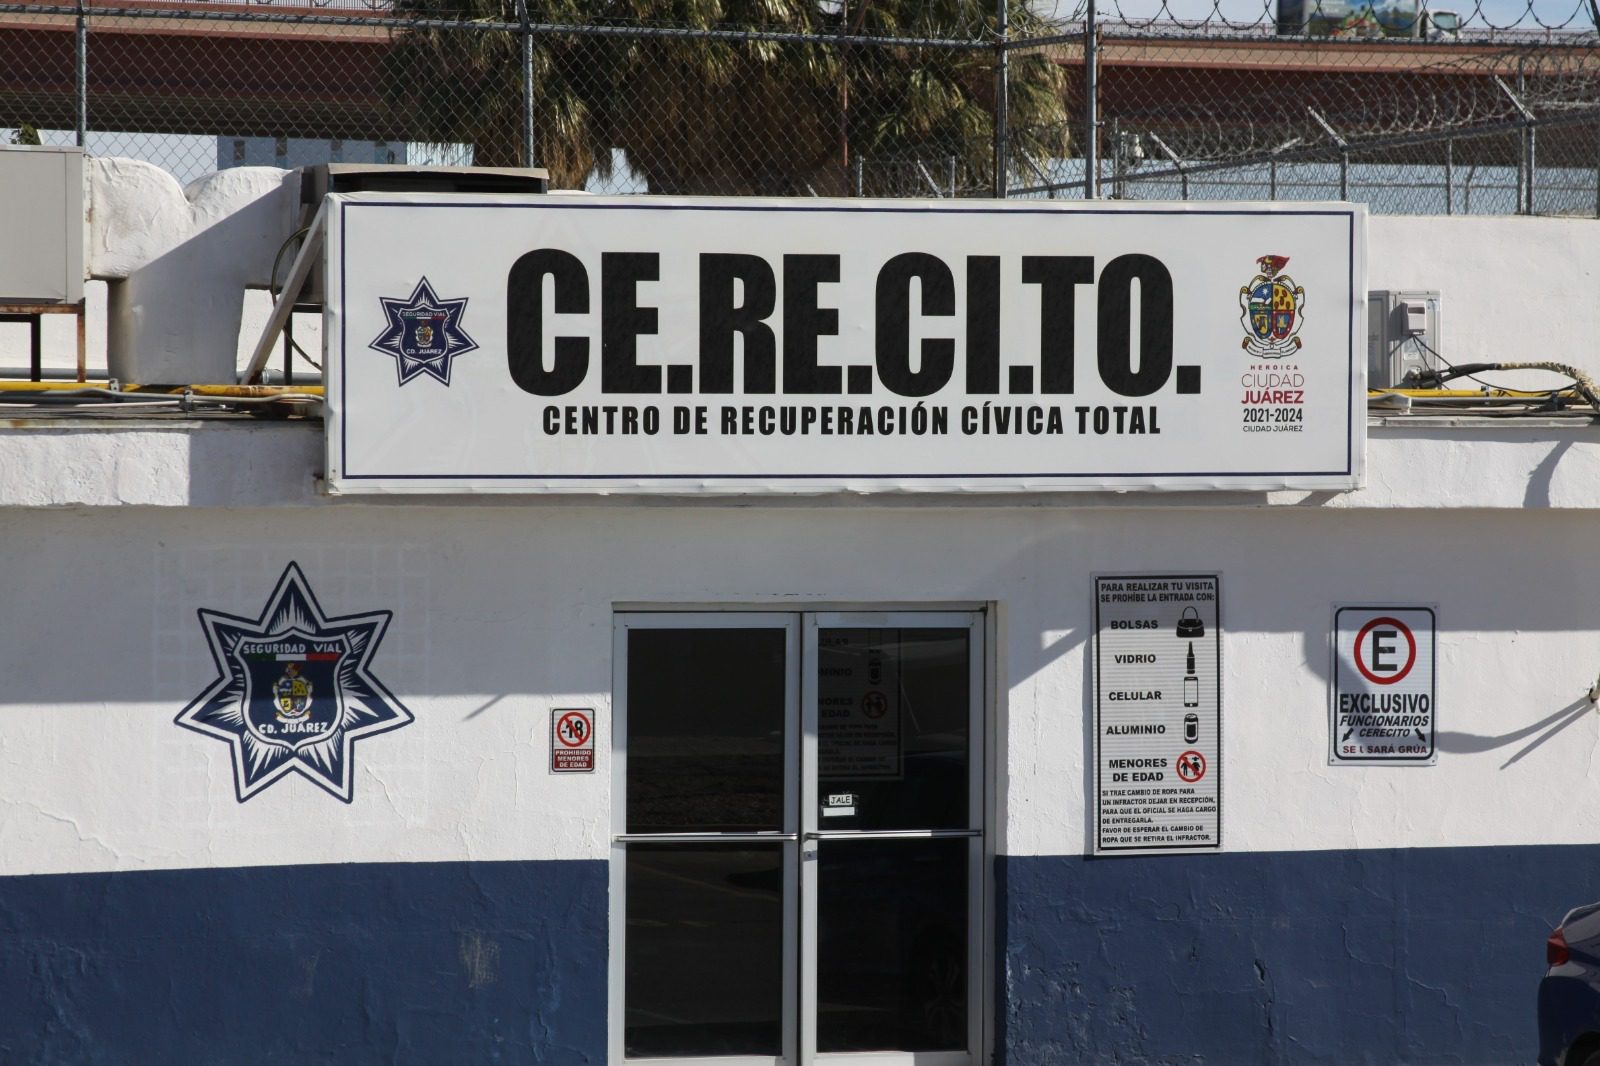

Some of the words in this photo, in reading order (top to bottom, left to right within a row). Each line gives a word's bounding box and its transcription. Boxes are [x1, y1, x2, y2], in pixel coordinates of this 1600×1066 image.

[507, 248, 1201, 397] CE.RE.CI.TO.
[1241, 373, 1304, 388] CIUDAD
[1241, 386, 1304, 404] JUÁREZ
[543, 405, 660, 436] CENTRO
[673, 405, 708, 435] DE
[721, 401, 948, 436] RECUPERACIÓN
[961, 401, 1064, 435] CÍVICA
[1075, 406, 1160, 435] TOTAL
[1243, 408, 1303, 423] 2021-2024
[1273, 424, 1303, 432] JUÁREZ
[1101, 583, 1124, 592] PARA
[1126, 582, 1168, 591] REALIZAR
[1171, 582, 1182, 590] TU
[1185, 582, 1214, 590] VISITA
[1100, 594, 1110, 602] SE
[1147, 594, 1157, 602] LA
[1159, 593, 1194, 601] ENTRADA
[1196, 592, 1215, 601] CON:
[1110, 620, 1158, 630] BOLSAS
[243, 644, 306, 654] SEGURIDAD
[313, 643, 342, 653] VIAL
[1372, 630, 1398, 672] E
[1114, 654, 1156, 664] VIDRIO
[1108, 692, 1162, 700] CELULAR
[1340, 694, 1430, 714] EXCLUSIVO
[1340, 716, 1430, 726] FUNCIONARIOS
[258, 723, 278, 734] CD.
[281, 721, 328, 734] JUÁREZ
[1106, 725, 1166, 735] ALUMINIO
[1359, 728, 1410, 738] CERECITO
[1343, 746, 1356, 754] SE
[1400, 744, 1428, 754] GRÚA
[1108, 758, 1168, 768] MENORES
[1112, 773, 1128, 782] DE
[1132, 772, 1164, 782] EDAD
[830, 796, 850, 804] JALE
